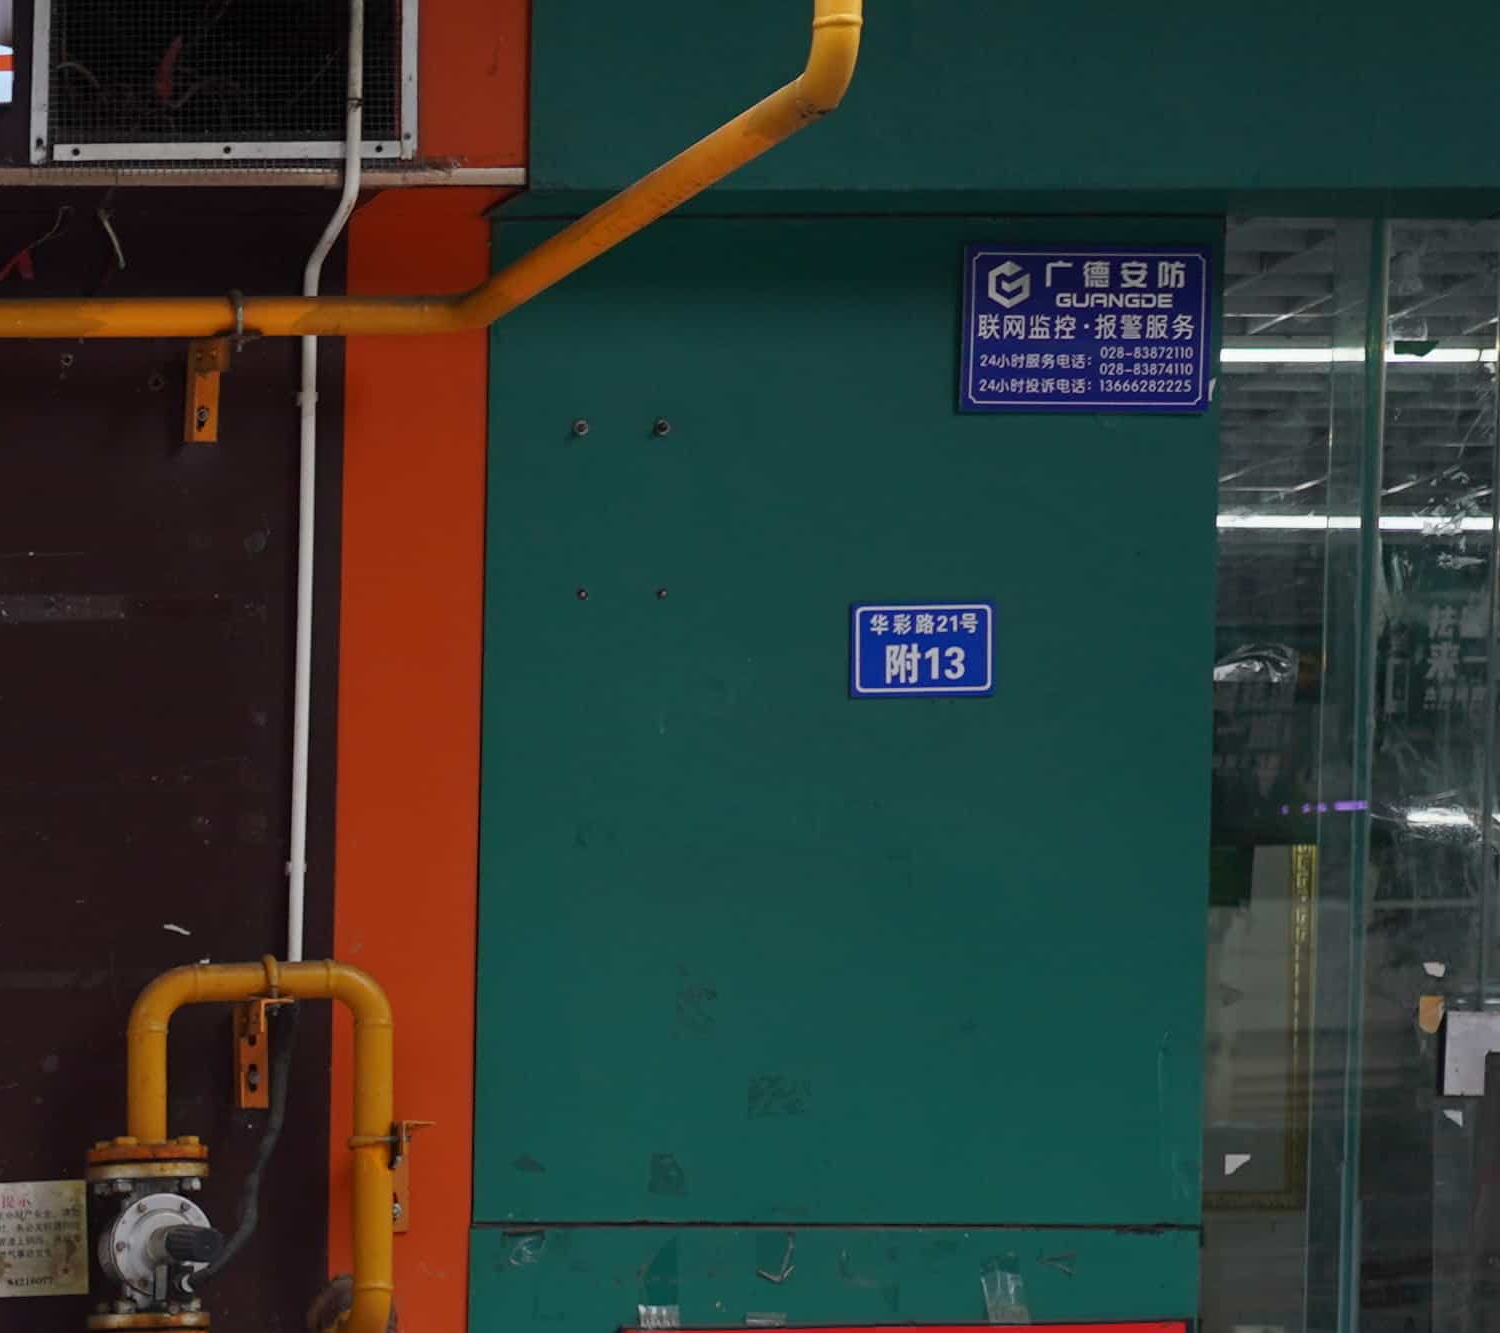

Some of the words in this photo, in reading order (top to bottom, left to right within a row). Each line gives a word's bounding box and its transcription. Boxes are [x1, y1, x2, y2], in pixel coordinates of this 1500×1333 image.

[1045, 261, 1186, 288] 广德安防
[1056, 293, 1173, 308] GUANGDE
[1100, 346, 1194, 359] 028-83872110
[1100, 363, 1194, 376] 028-83874110
[1100, 380, 1192, 393] 13666282225
[870, 614, 979, 637] 华彩路21号
[885, 643, 966, 685] 附13
